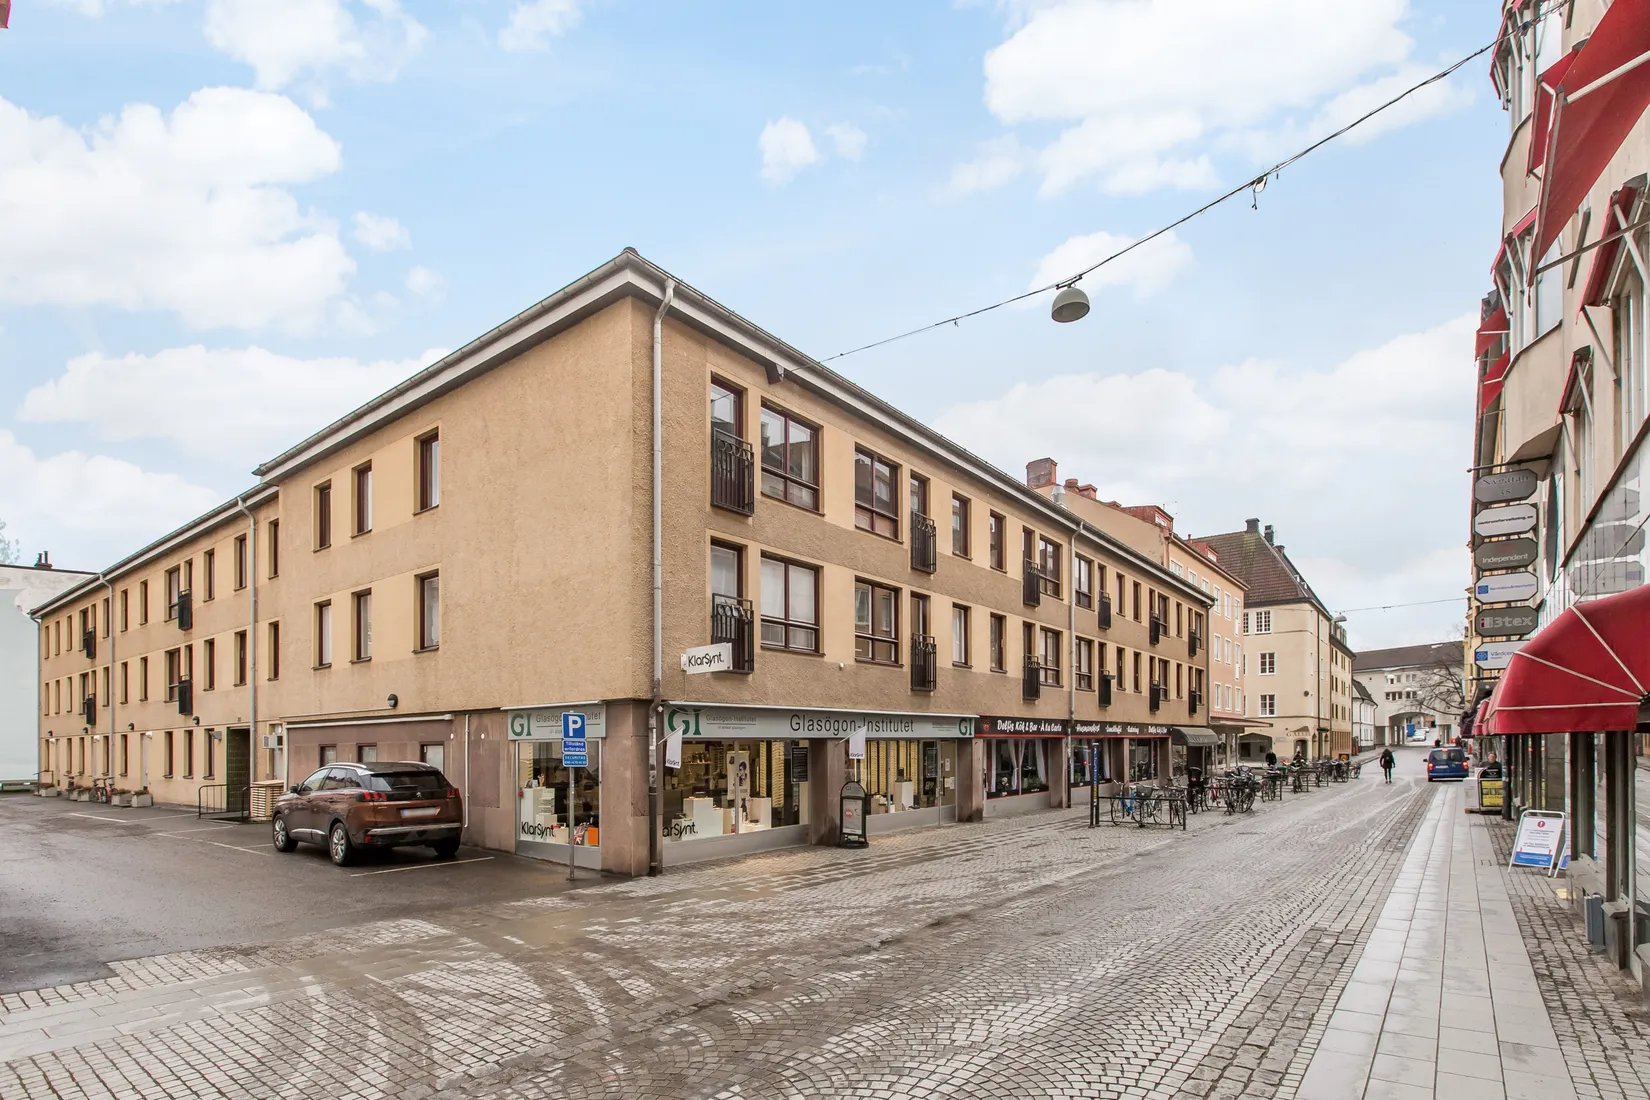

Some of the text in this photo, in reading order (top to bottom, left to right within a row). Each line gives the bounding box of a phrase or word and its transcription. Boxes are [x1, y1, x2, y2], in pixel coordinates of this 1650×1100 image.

[1482, 553, 1529, 564] Independent
[687, 651, 725, 668] KlarSynt.
[510, 711, 532, 737] GI
[568, 715, 582, 737] P
[667, 707, 702, 736] GI
[790, 713, 914, 736] Glasögon-Institutet
[958, 718, 974, 736] GI
[662, 821, 699, 839] arSynt.
